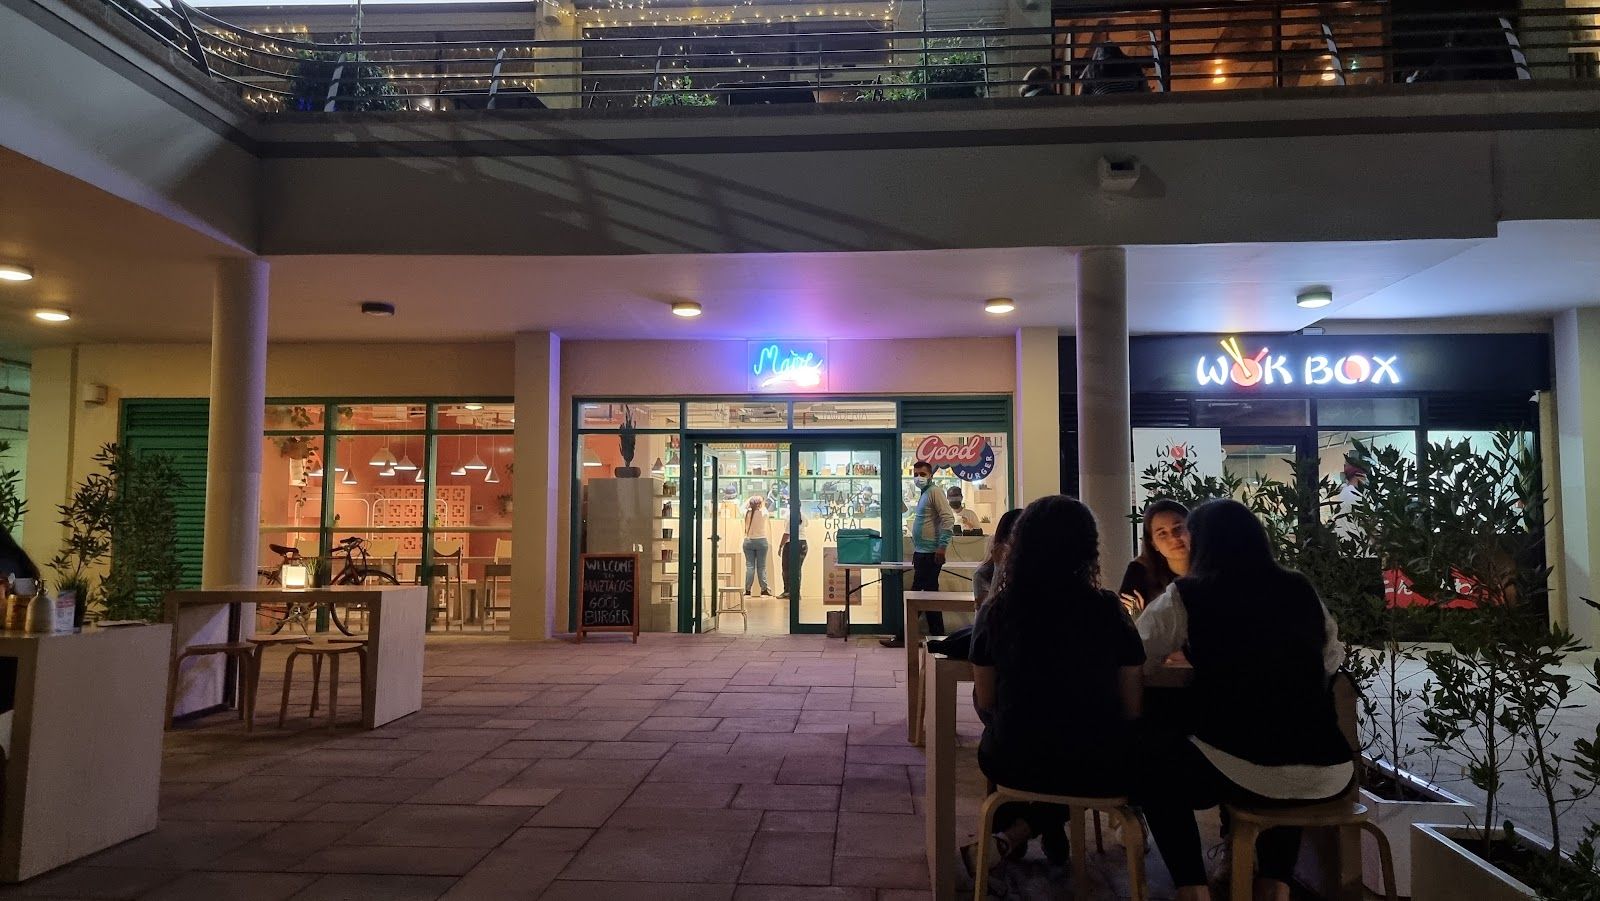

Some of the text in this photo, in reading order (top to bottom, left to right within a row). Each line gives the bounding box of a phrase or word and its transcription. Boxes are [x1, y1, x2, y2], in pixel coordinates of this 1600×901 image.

[1196, 347, 1400, 387] WOK BOX
[917, 436, 980, 463] Good
[959, 455, 993, 480] BURGER
[824, 518, 862, 530] GREAT
[585, 609, 631, 625] BURGER
